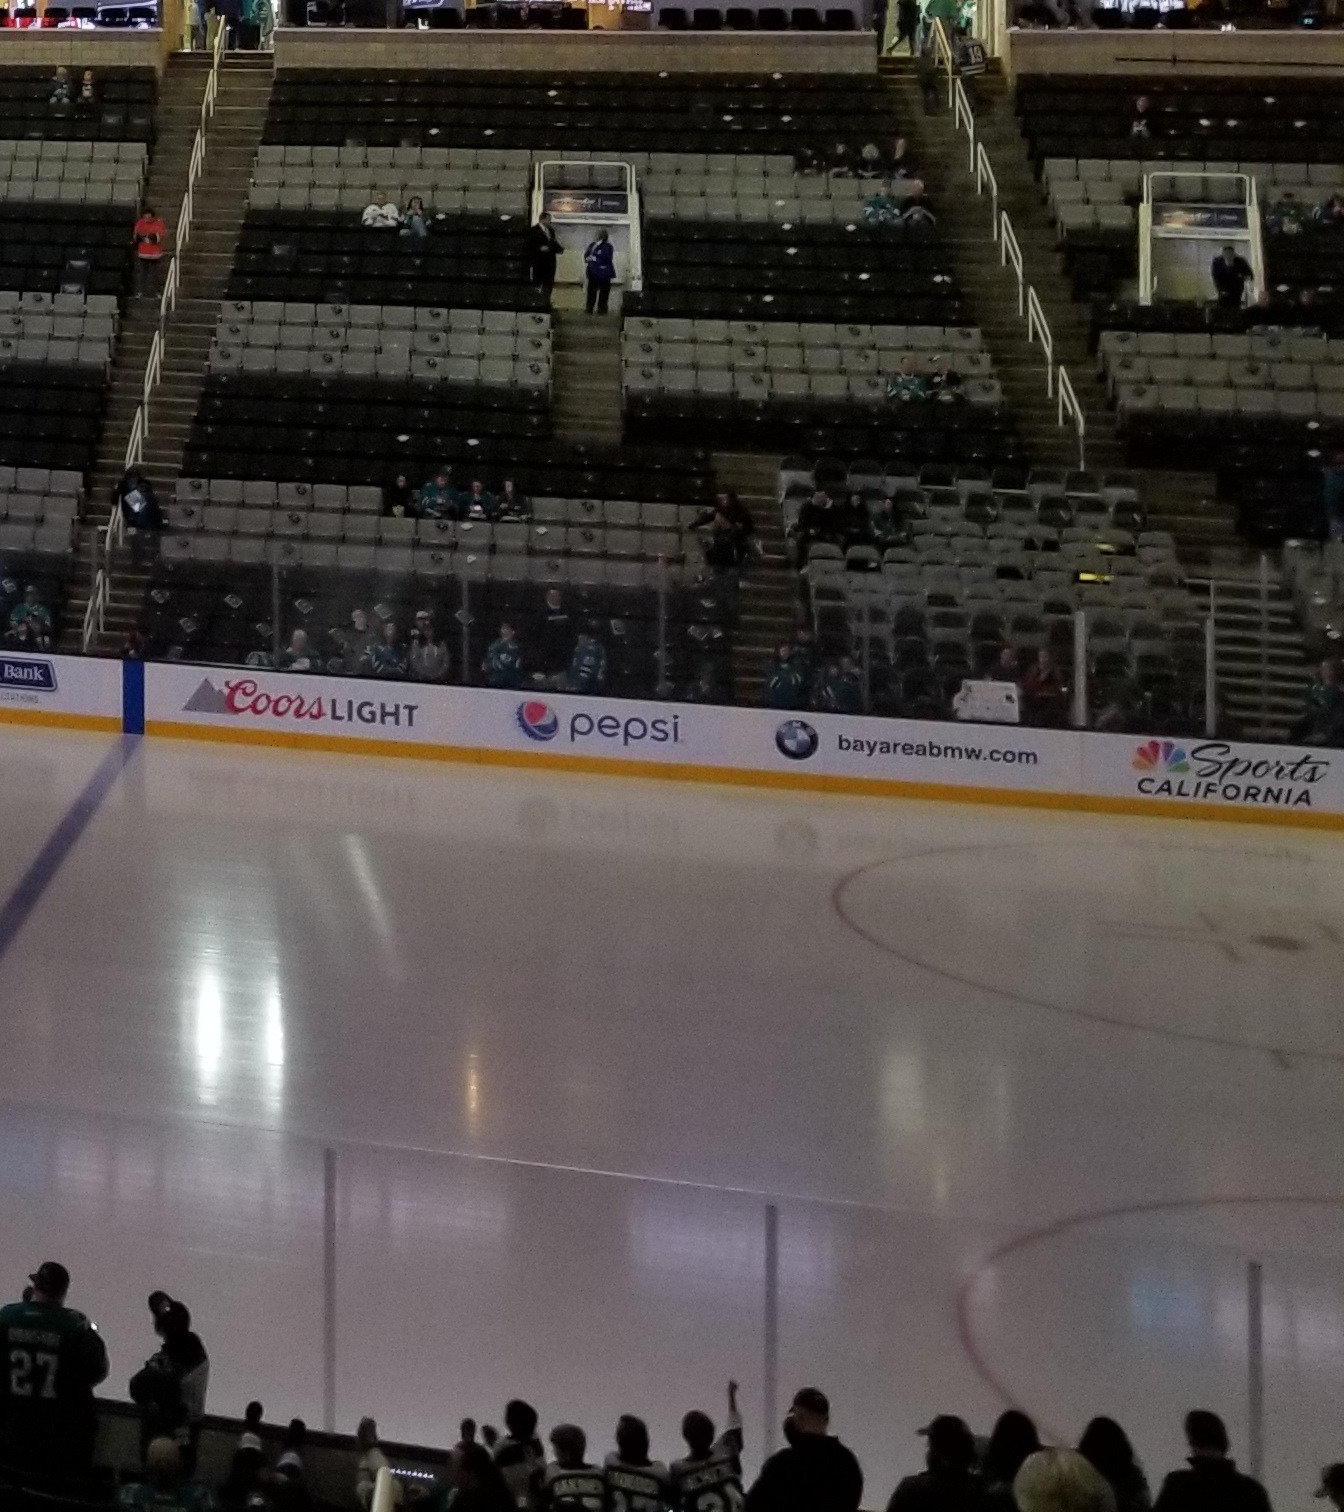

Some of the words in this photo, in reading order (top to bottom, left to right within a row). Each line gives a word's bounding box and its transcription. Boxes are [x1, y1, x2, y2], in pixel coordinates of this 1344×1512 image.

[3, 663, 45, 681] Bank
[224, 678, 326, 720] Coors
[330, 698, 419, 727] LIGHT
[569, 714, 680, 746] pepsi
[837, 734, 1039, 766] bayareabmw.com
[1191, 742, 1330, 784] Sports
[1136, 777, 1312, 807] CALIFORNIA
[9, 1348, 59, 1399] 27
